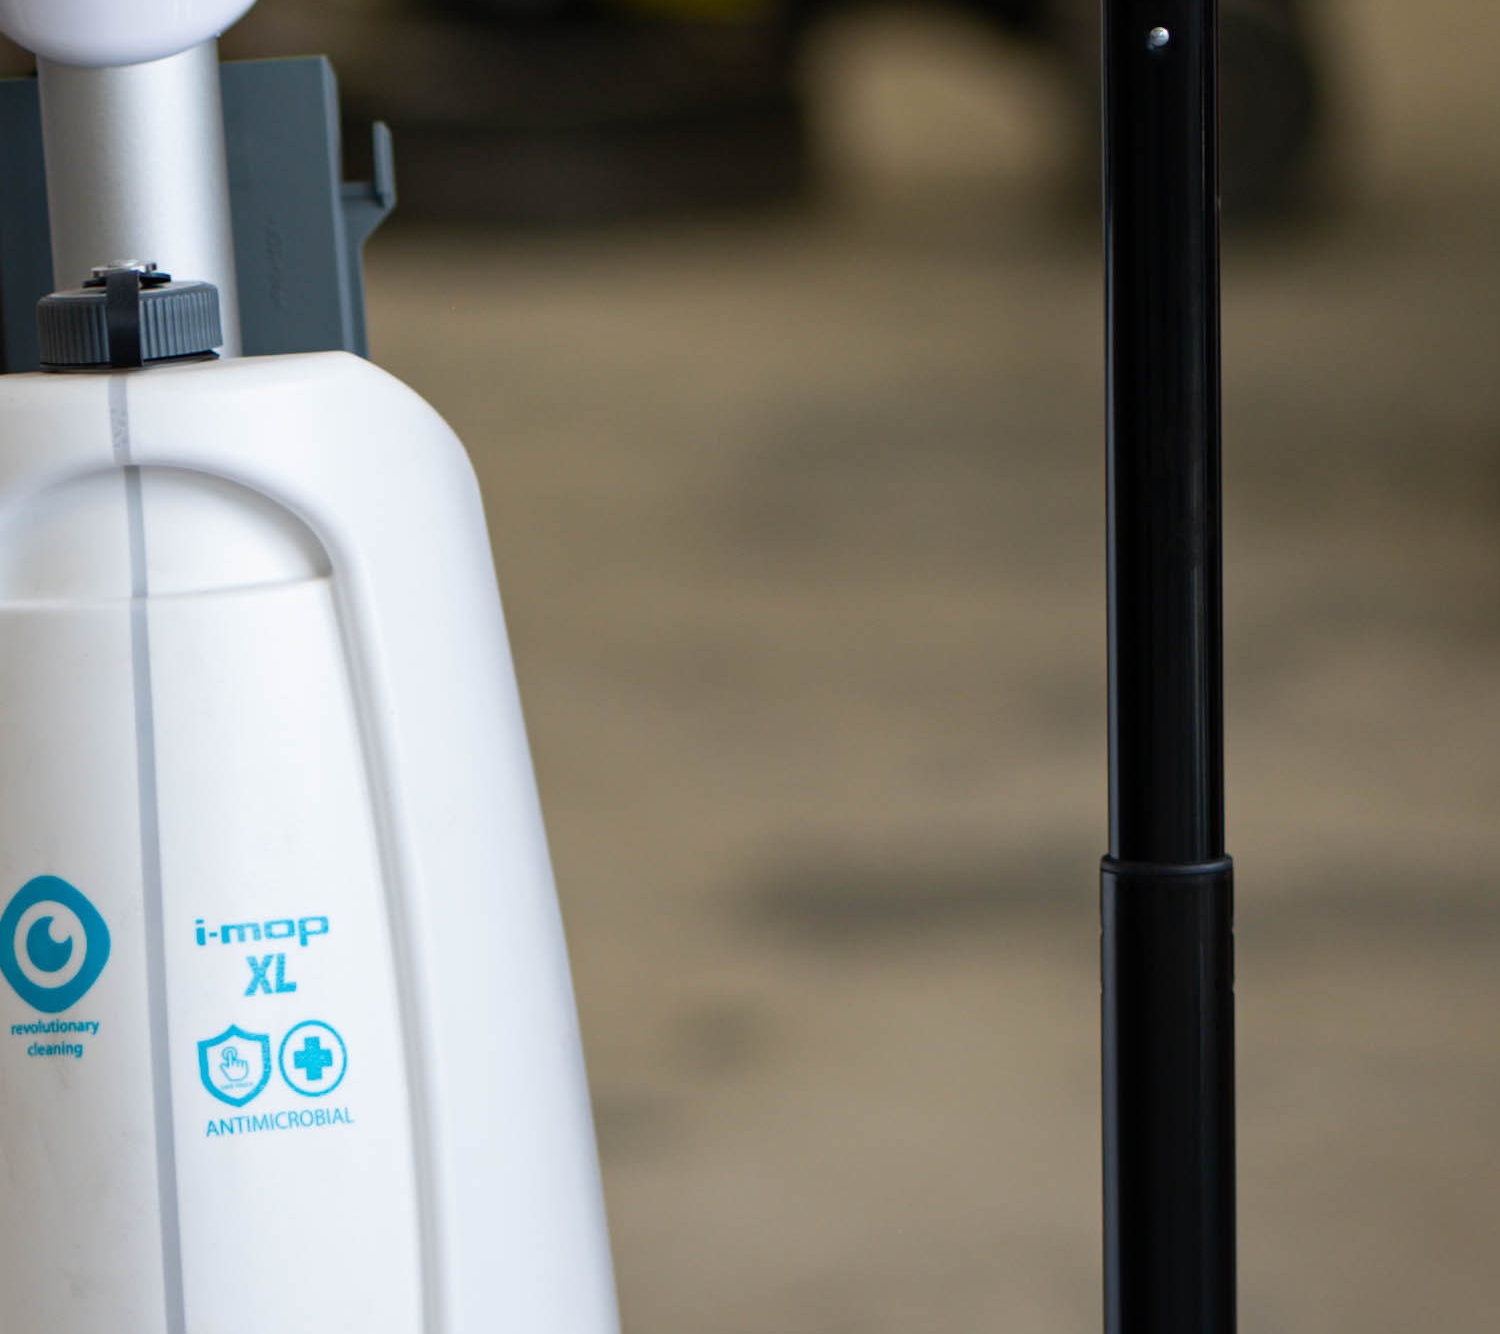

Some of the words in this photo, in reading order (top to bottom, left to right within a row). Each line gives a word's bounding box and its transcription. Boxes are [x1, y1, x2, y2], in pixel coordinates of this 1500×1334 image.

[195, 915, 329, 947] i-mop
[244, 952, 297, 997] XL
[10, 1018, 100, 1036] revolutionary
[26, 1041, 84, 1059] cleaning
[205, 1107, 355, 1137] ANTIMICROBIAL
